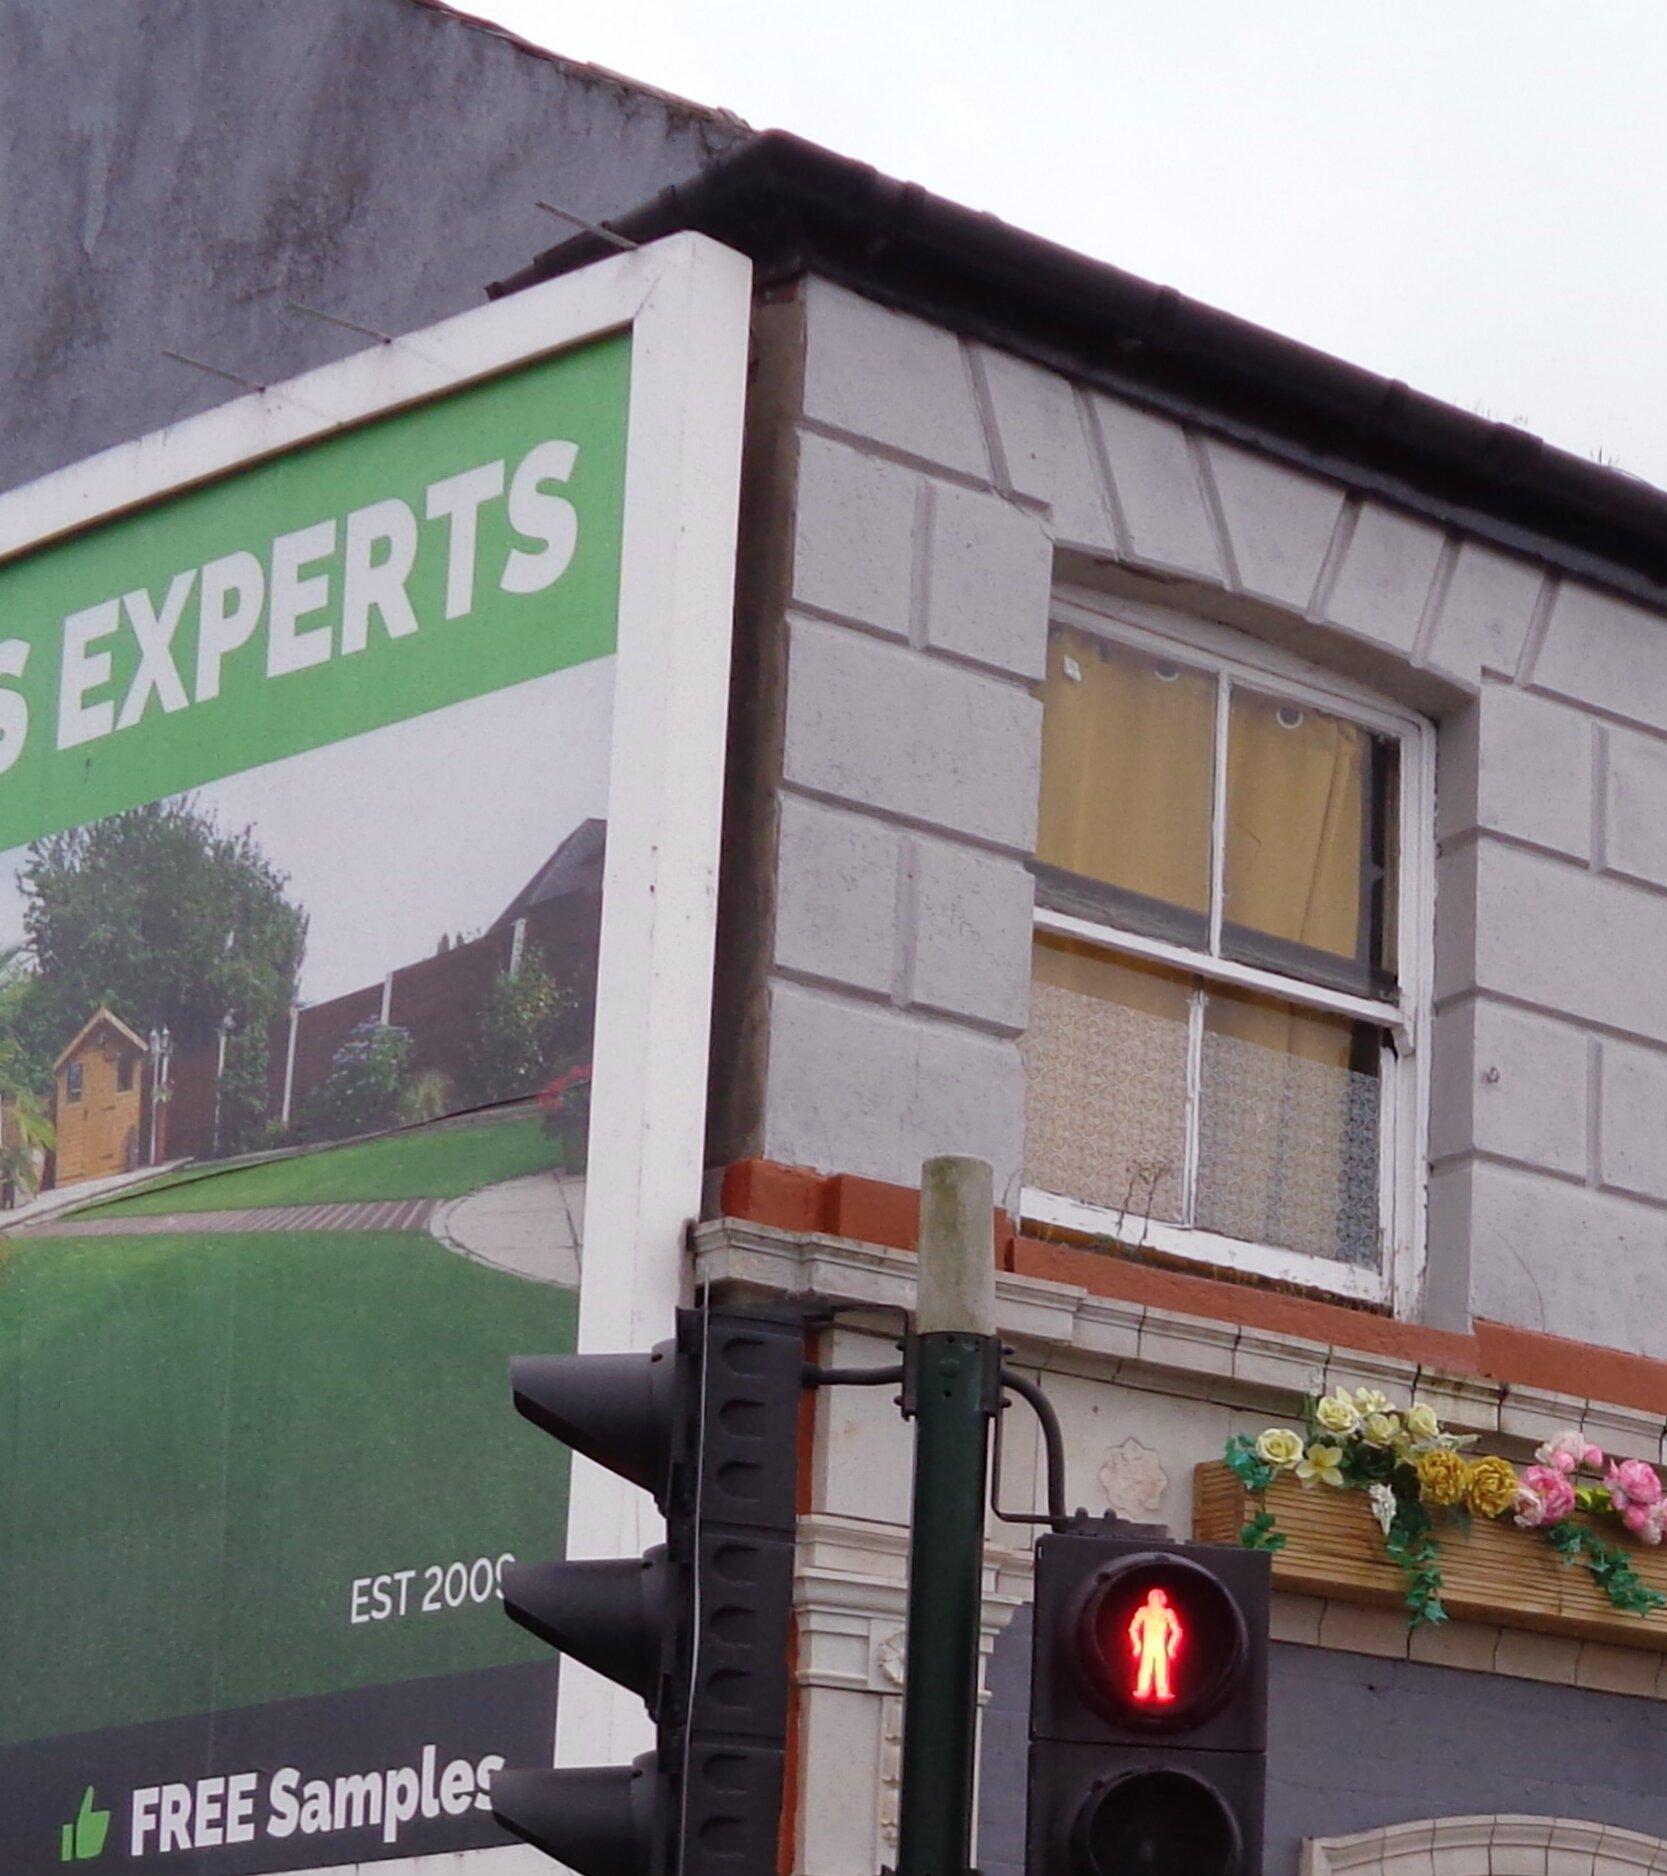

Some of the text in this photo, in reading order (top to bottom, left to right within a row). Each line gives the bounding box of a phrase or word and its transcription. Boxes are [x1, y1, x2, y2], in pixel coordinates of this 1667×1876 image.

[57, 440, 580, 751] EXPERTS
[351, 1570, 416, 1624] EST
[131, 1744, 506, 1856] FREE Samples
